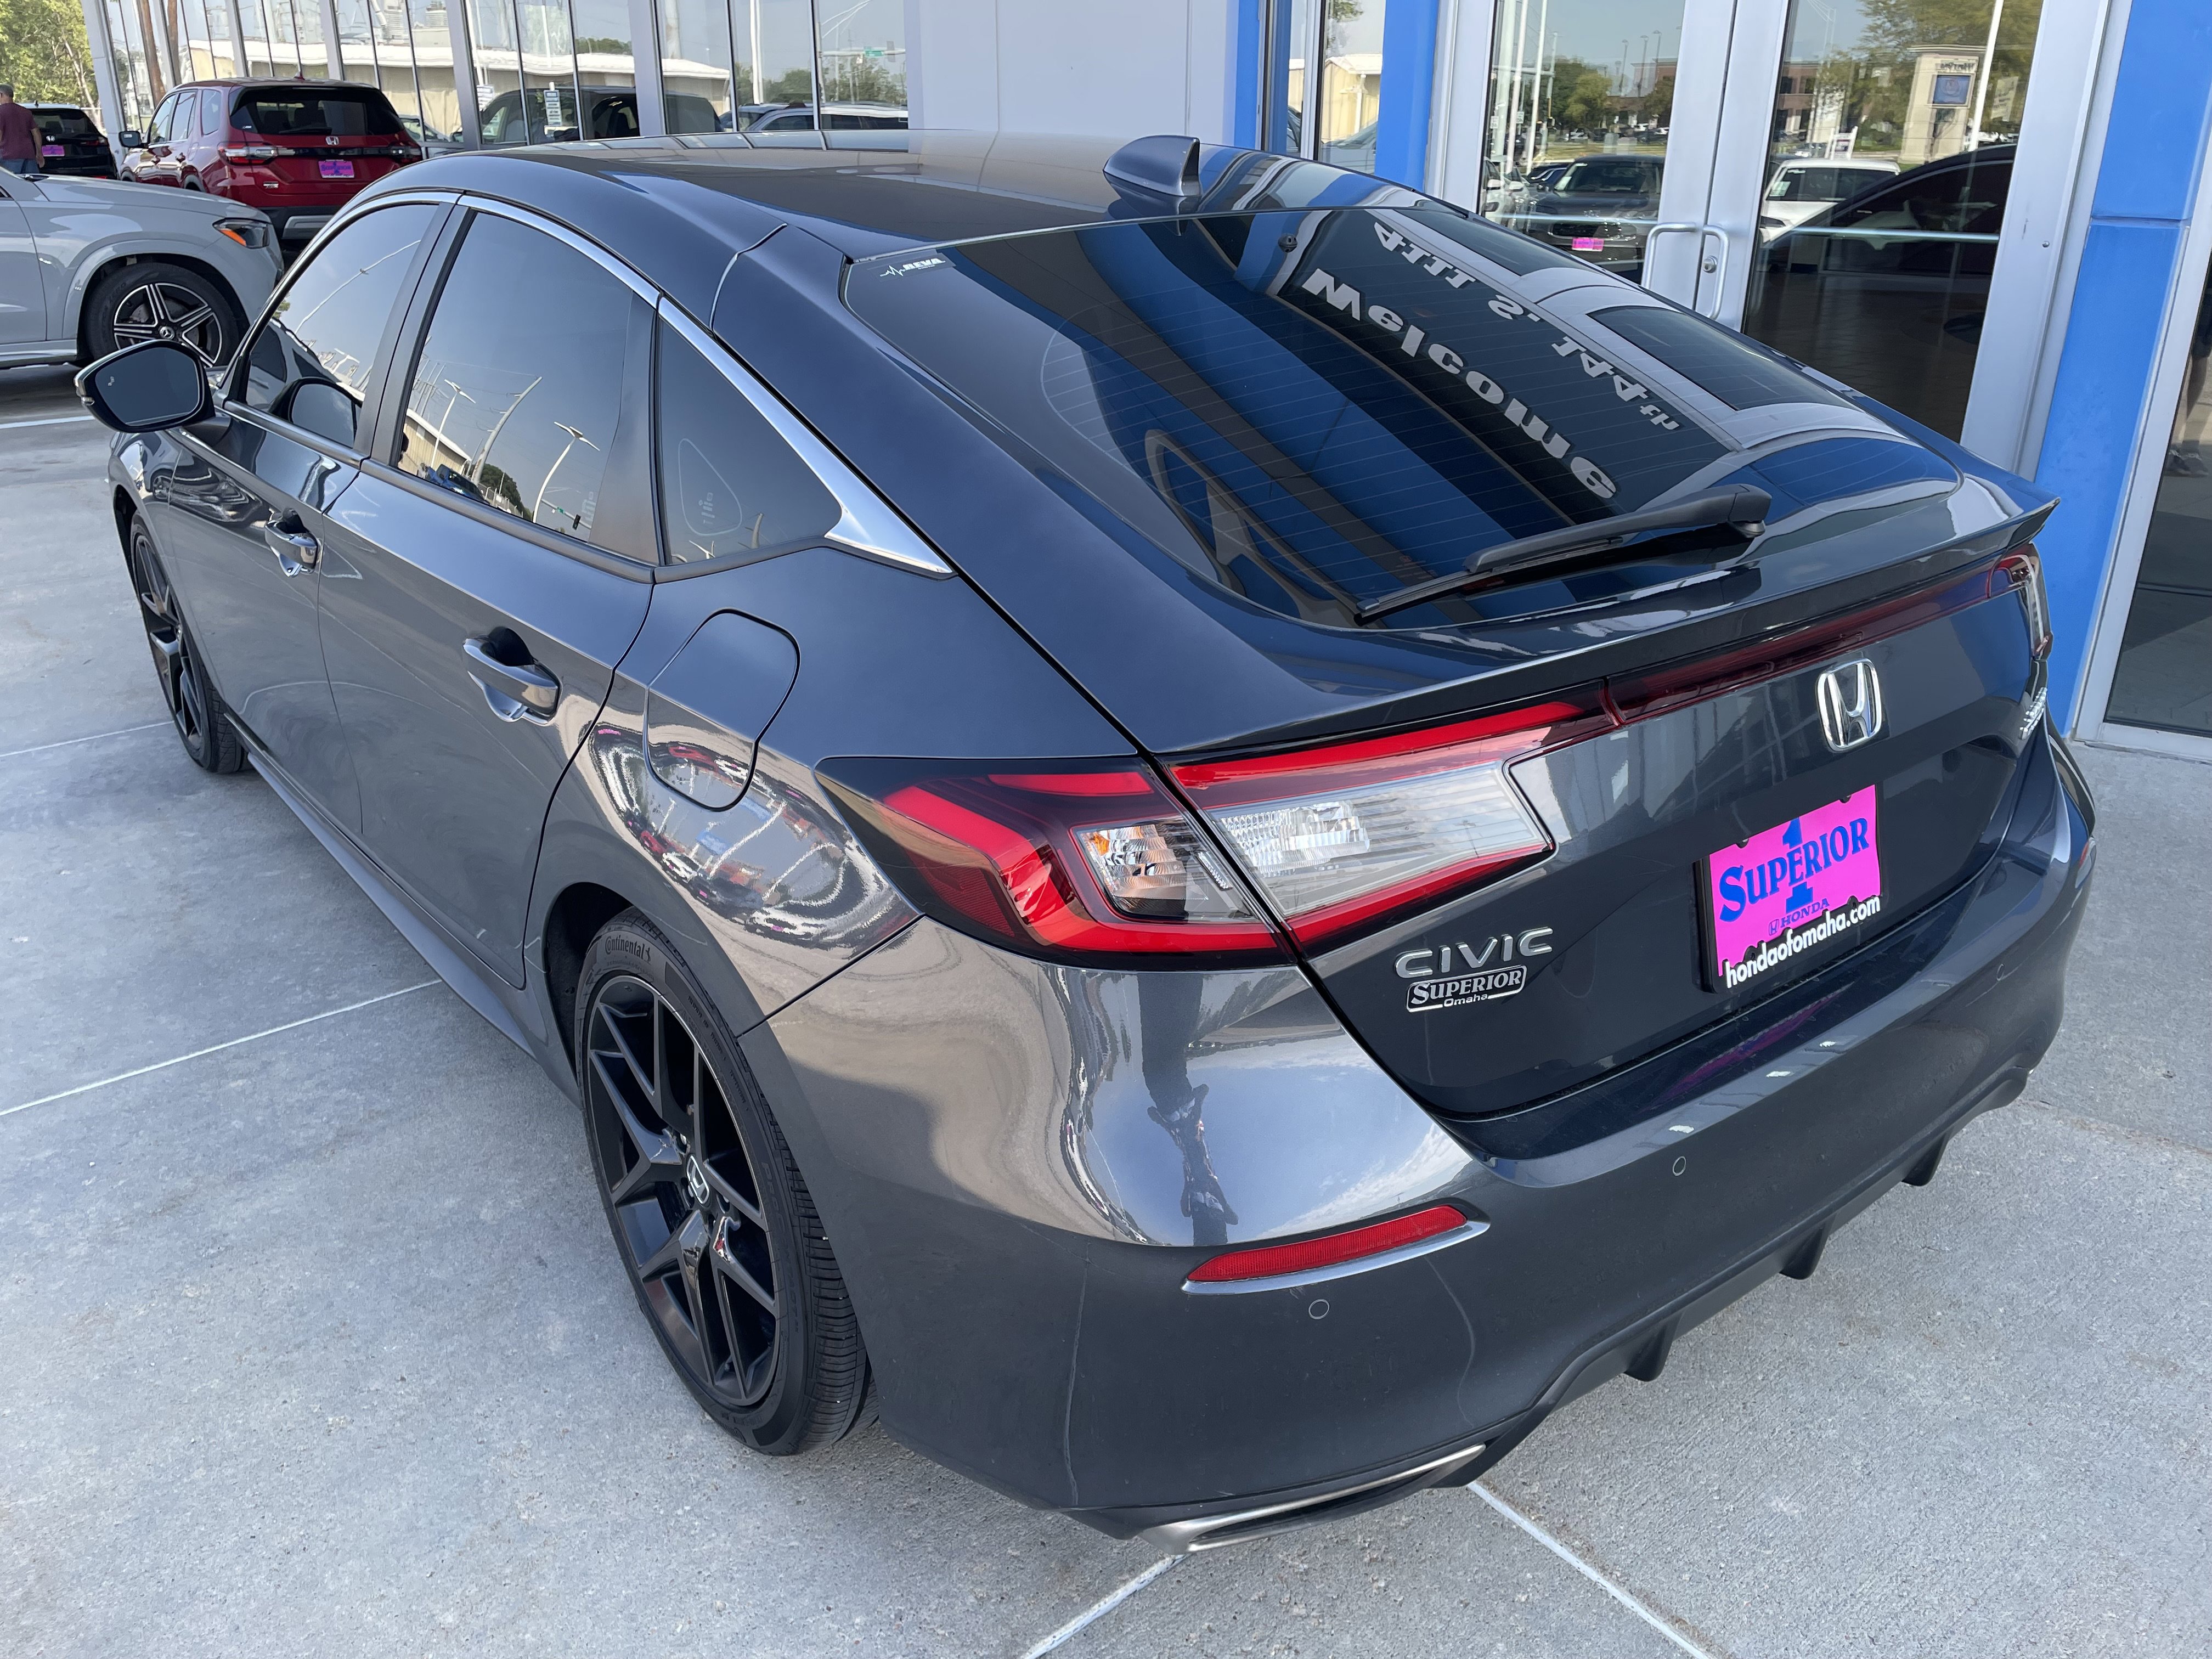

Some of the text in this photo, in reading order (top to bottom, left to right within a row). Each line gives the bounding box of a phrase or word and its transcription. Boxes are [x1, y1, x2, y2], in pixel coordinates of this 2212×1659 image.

[1719, 817, 1870, 922] SUPERIOR
[1780, 898, 1830, 929] HONDA
[605, 934, 645, 960] Continental
[1394, 926, 1554, 979] CIVIC
[1725, 895, 1881, 989] hondaofomaha.com
[1410, 969, 1523, 1005] SUPERIOR
[1443, 994, 1488, 1007] Omaha
